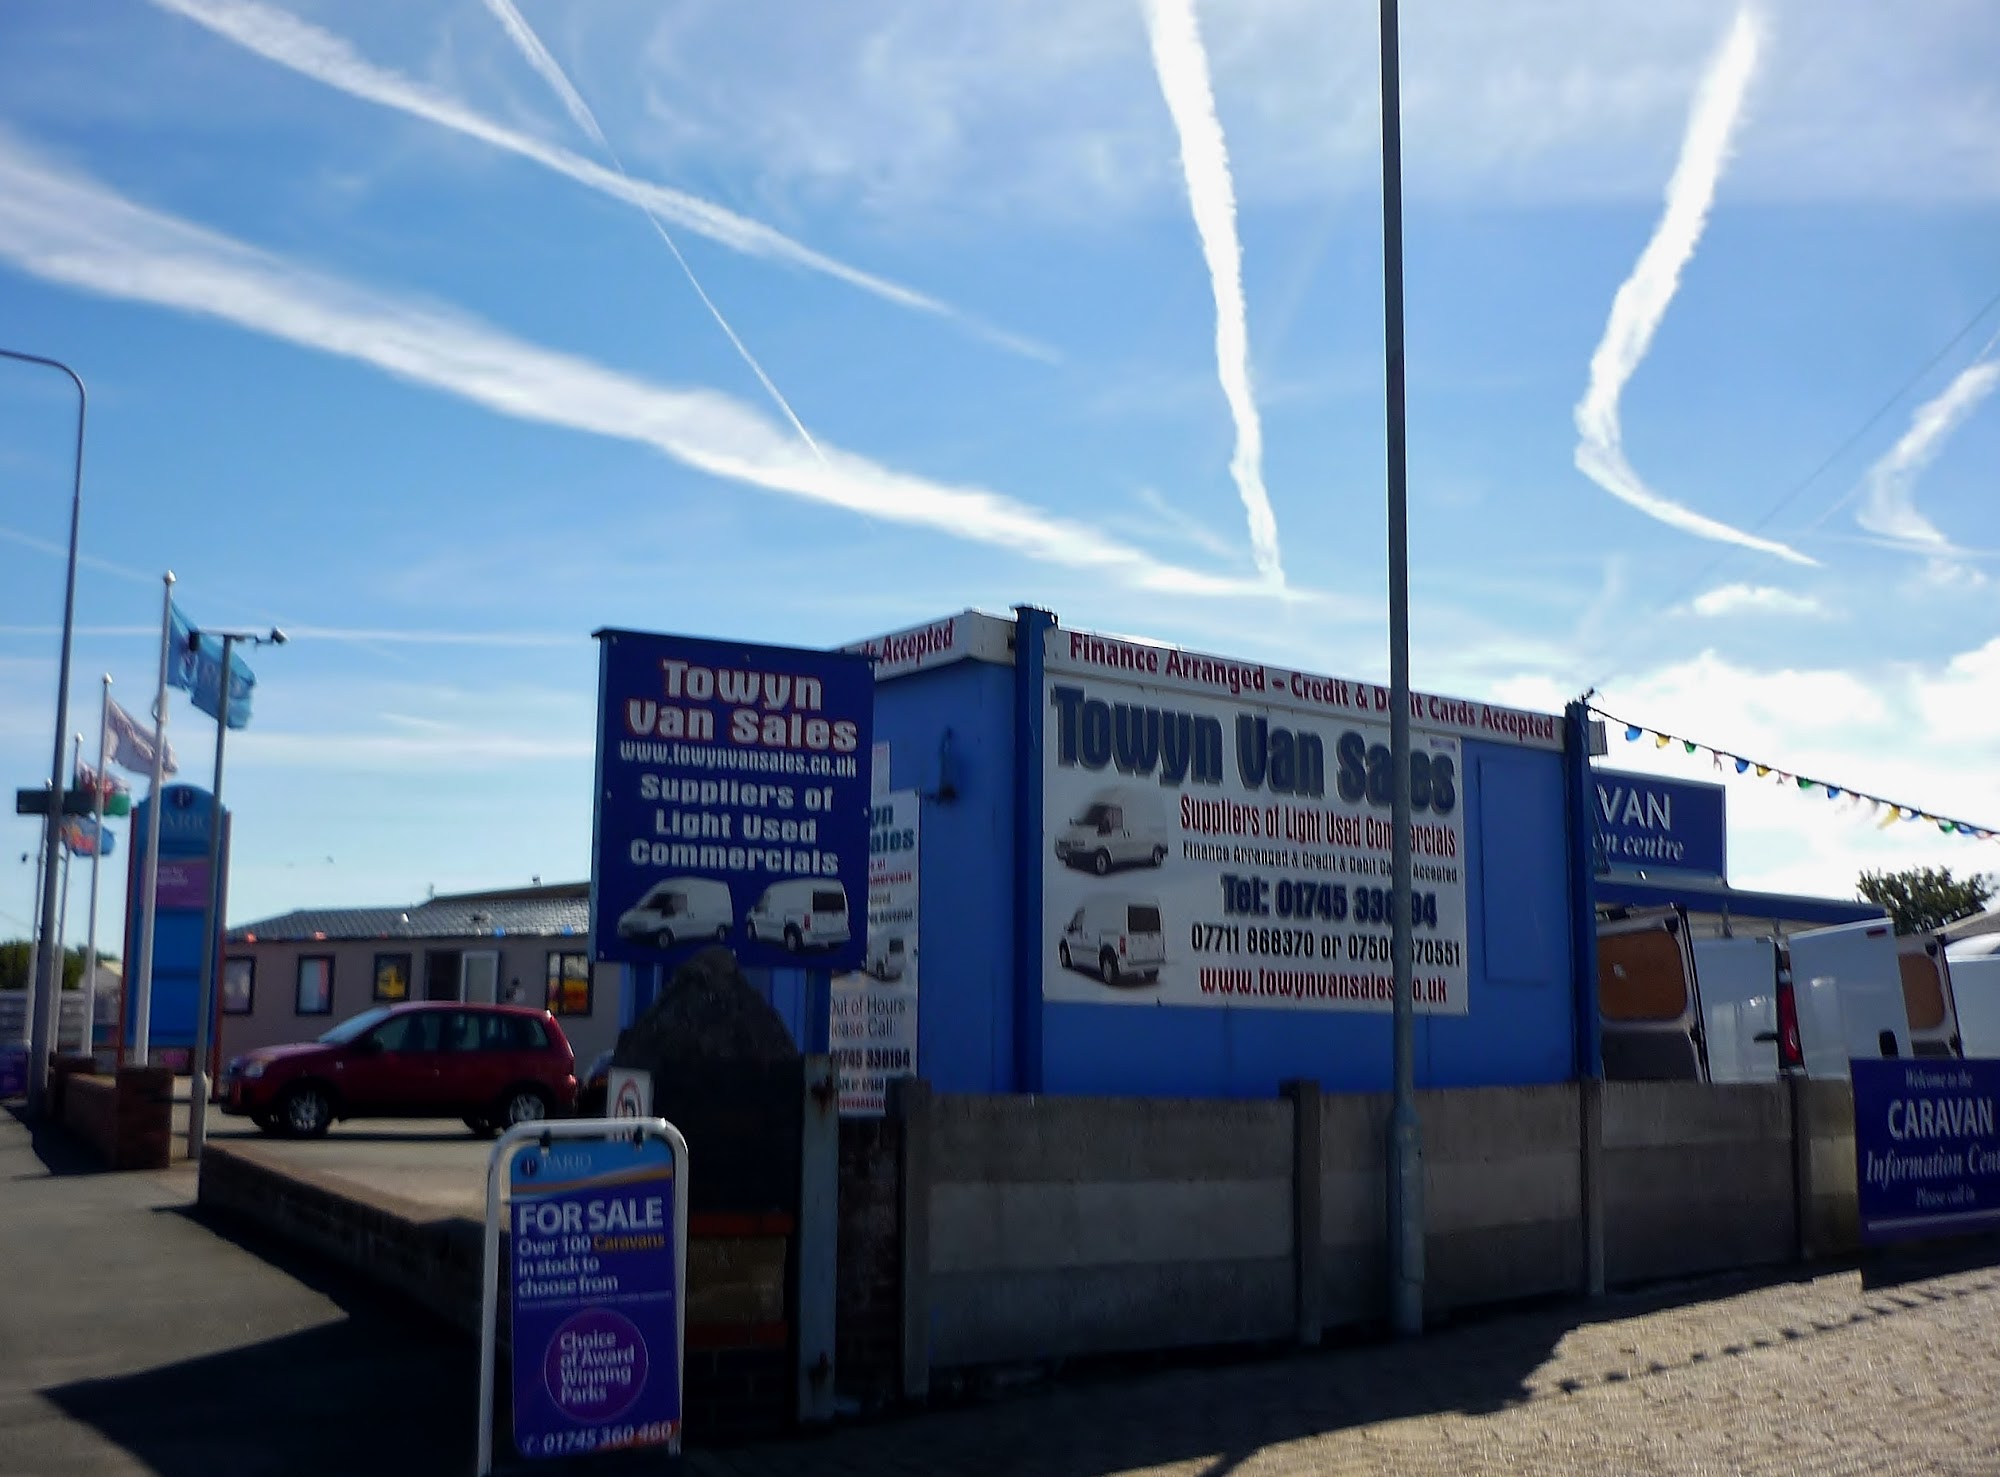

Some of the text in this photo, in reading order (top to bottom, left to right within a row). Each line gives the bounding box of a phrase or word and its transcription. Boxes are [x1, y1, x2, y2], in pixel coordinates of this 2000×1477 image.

[879, 617, 955, 666] Accepted
[662, 658, 822, 711] Towyn
[1069, 631, 1159, 674] Finance
[1165, 649, 1266, 696] Arranged
[1290, 670, 1349, 708] Credit
[1355, 683, 1369, 712] &
[1373, 685, 1423, 719] Dit
[1428, 696, 1476, 727] Cards
[1481, 704, 1554, 741] Accepted
[628, 698, 857, 751] Van Sales
[619, 741, 857, 777] www.towynvansales.co.uk
[1051, 682, 1456, 816] Towyn Van Saes
[640, 773, 834, 812] Suppliers of
[656, 808, 817, 844] Light Used
[1180, 793, 1456, 858] Suppliers of Light Used Comercials
[630, 838, 839, 876] Commercials
[1183, 840, 1229, 863] Finance
[1233, 844, 1289, 868] Arranged
[1302, 851, 1337, 872] Credit
[1349, 855, 1376, 876] Debit
[1412, 862, 1457, 884] Accepted
[1623, 834, 1685, 861] centre
[1220, 872, 1270, 917] Tel:
[1275, 878, 1348, 921] 01745
[1191, 921, 1240, 954] 07711
[1320, 933, 1342, 960] or
[1348, 934, 1393, 962] 0750
[1200, 967, 1447, 1003] www.towynvansaleso.uk
[1888, 1097, 1994, 1141] CARAVAN
[1866, 1146, 1963, 1192] Information
[519, 1196, 664, 1236] FOR SALE
[518, 1238, 557, 1257] Over
[562, 1235, 591, 1253] 100
[536, 1256, 580, 1276] stock
[583, 1255, 599, 1272] to
[518, 1272, 619, 1298] choose from
[560, 1329, 617, 1350] Choice
[560, 1344, 635, 1369] of Award
[561, 1366, 632, 1386] Winning
[561, 1384, 607, 1405] Parks
